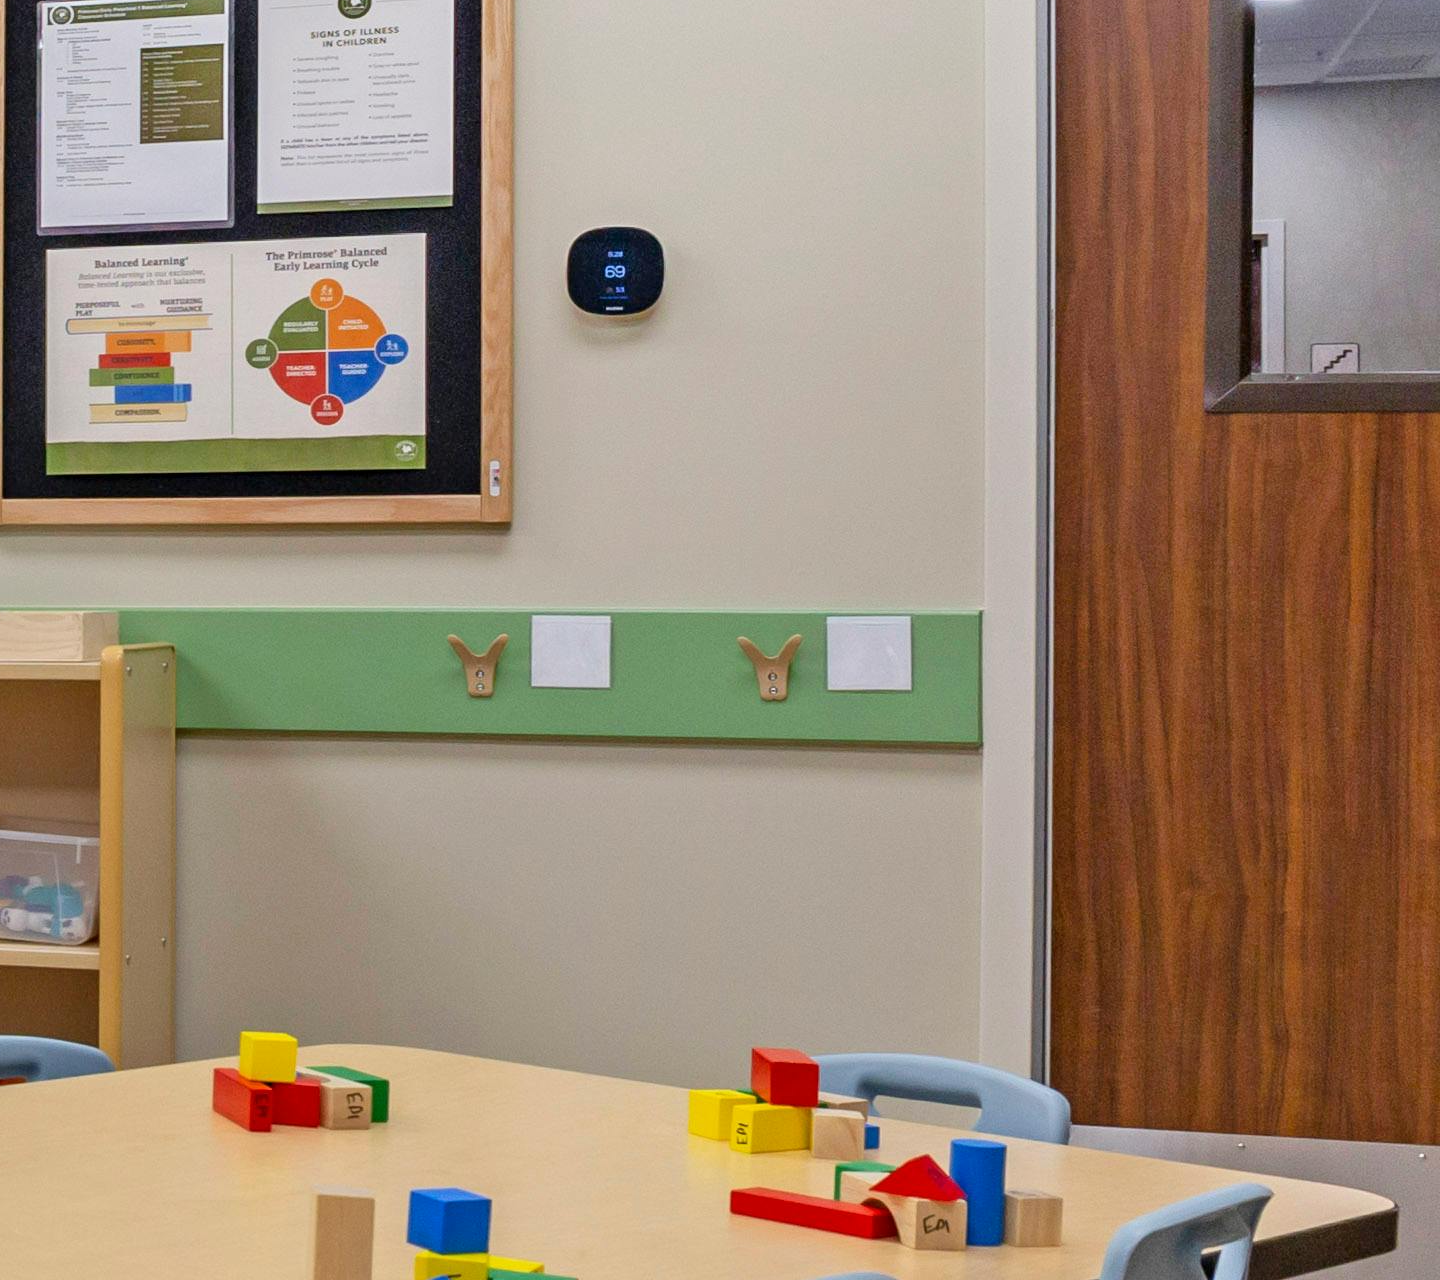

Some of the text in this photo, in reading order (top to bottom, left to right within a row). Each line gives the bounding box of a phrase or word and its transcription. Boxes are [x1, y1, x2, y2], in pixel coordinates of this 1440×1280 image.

[311, 26, 399, 39] SIGNS OF ILLNESS
[336, 38, 387, 46] CHILDREN
[266, 252, 284, 260] The
[341, 247, 387, 256] Balanced
[95, 258, 138, 268] Balanced
[274, 258, 378, 272] Early Learning Cycle
[605, 266, 625, 278] 69
